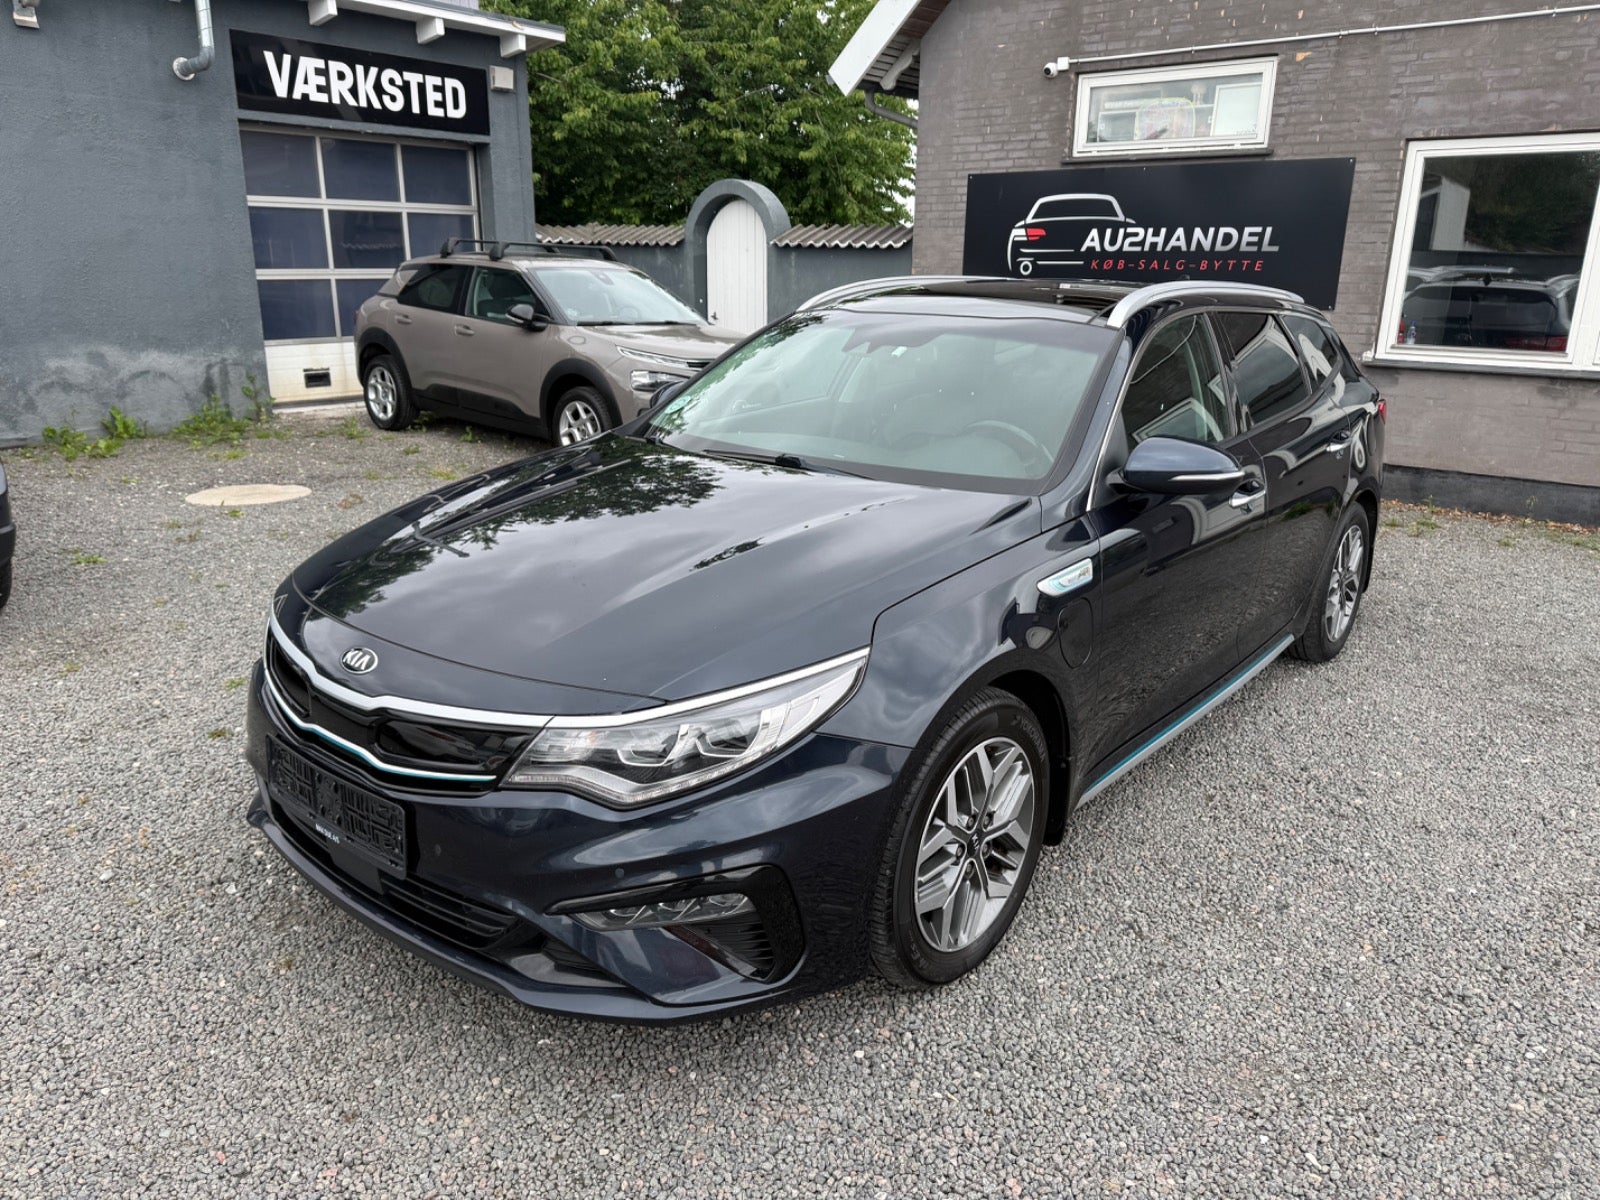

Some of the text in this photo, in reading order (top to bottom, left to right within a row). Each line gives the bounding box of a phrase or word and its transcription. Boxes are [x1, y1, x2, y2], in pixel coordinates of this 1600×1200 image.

[263, 50, 467, 119] VÆRKSTED
[1090, 259, 1264, 272] KØB-SALG-BYTTE
[342, 649, 371, 670] KIA
